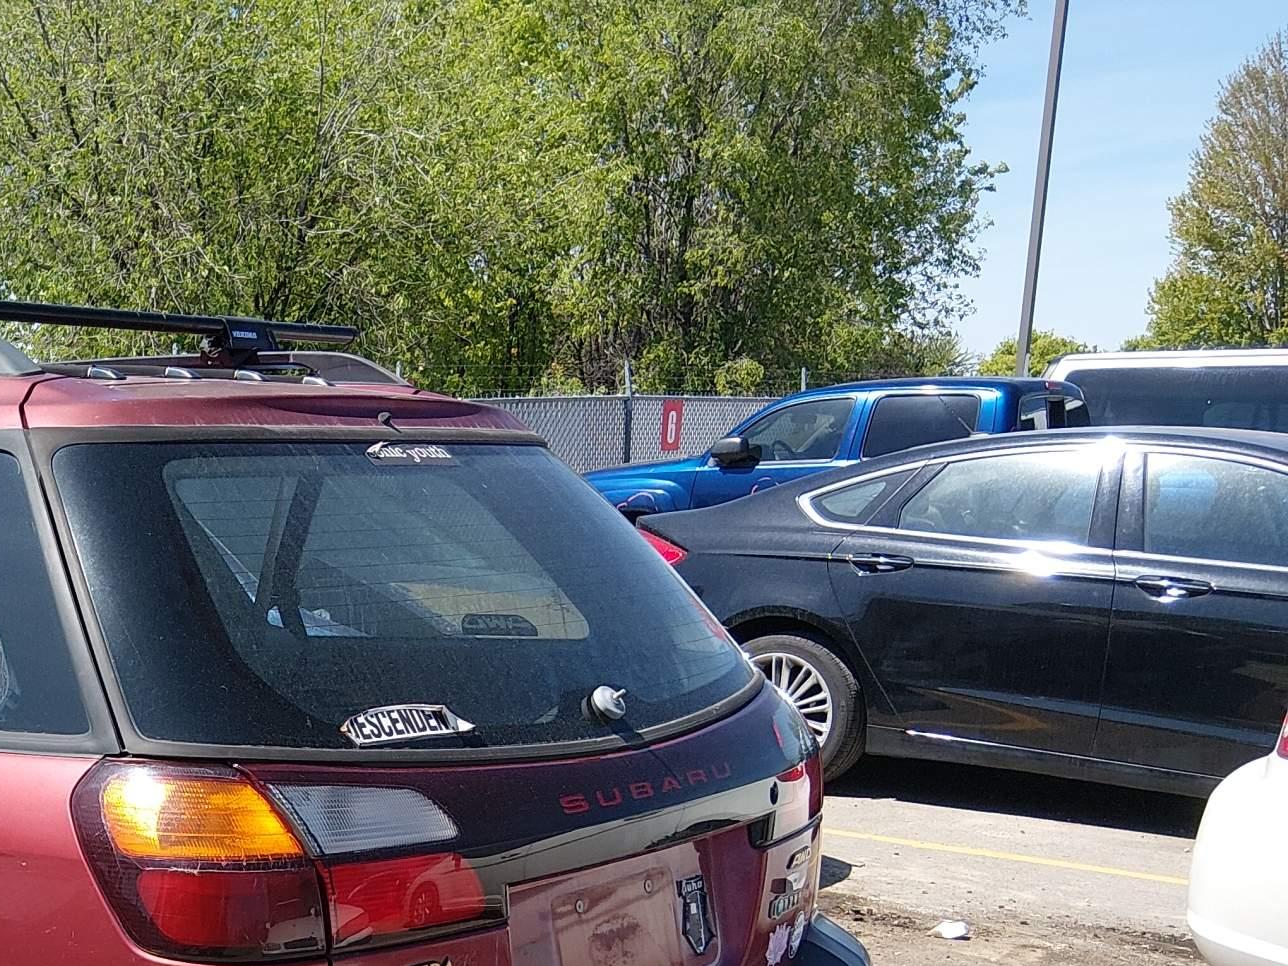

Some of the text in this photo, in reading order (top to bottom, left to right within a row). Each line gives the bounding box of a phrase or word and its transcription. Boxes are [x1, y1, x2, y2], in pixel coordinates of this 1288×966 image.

[666, 410, 677, 444] 6
[406, 445, 452, 463] youth
[559, 761, 730, 815] SUBARU
